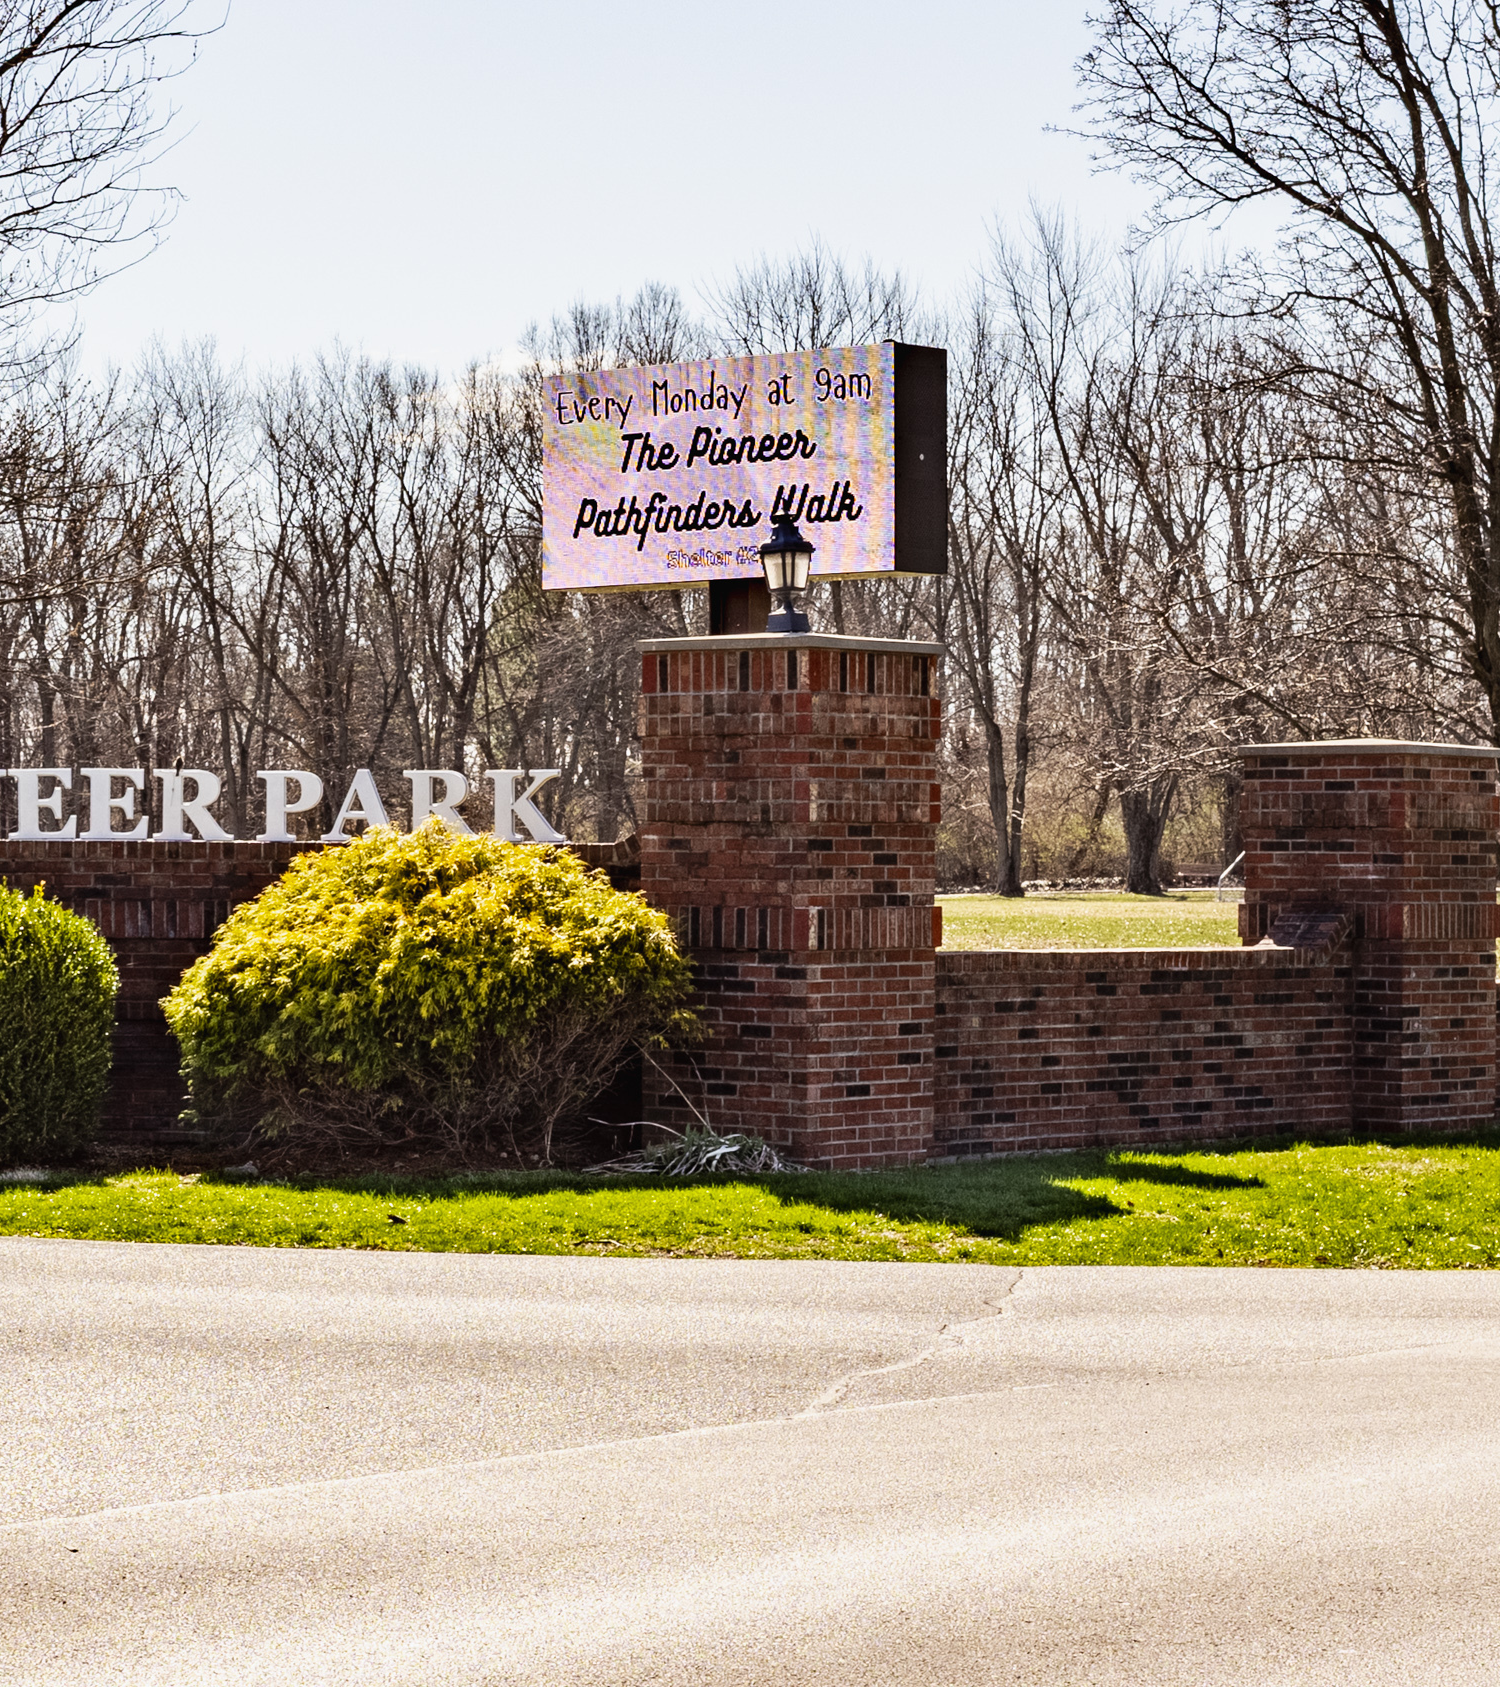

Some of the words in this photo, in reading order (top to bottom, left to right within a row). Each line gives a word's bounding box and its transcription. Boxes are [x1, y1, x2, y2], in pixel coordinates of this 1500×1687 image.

[555, 390, 634, 430] Every
[652, 369, 748, 420] Monday
[767, 373, 796, 406] at
[815, 367, 872, 402] 9am
[621, 431, 681, 474] The
[686, 425, 818, 469] Pioneer
[572, 490, 763, 552] Pathfinders
[770, 480, 864, 525] Walk
[666, 546, 733, 569] Shelter
[255, 767, 568, 844] PARK
